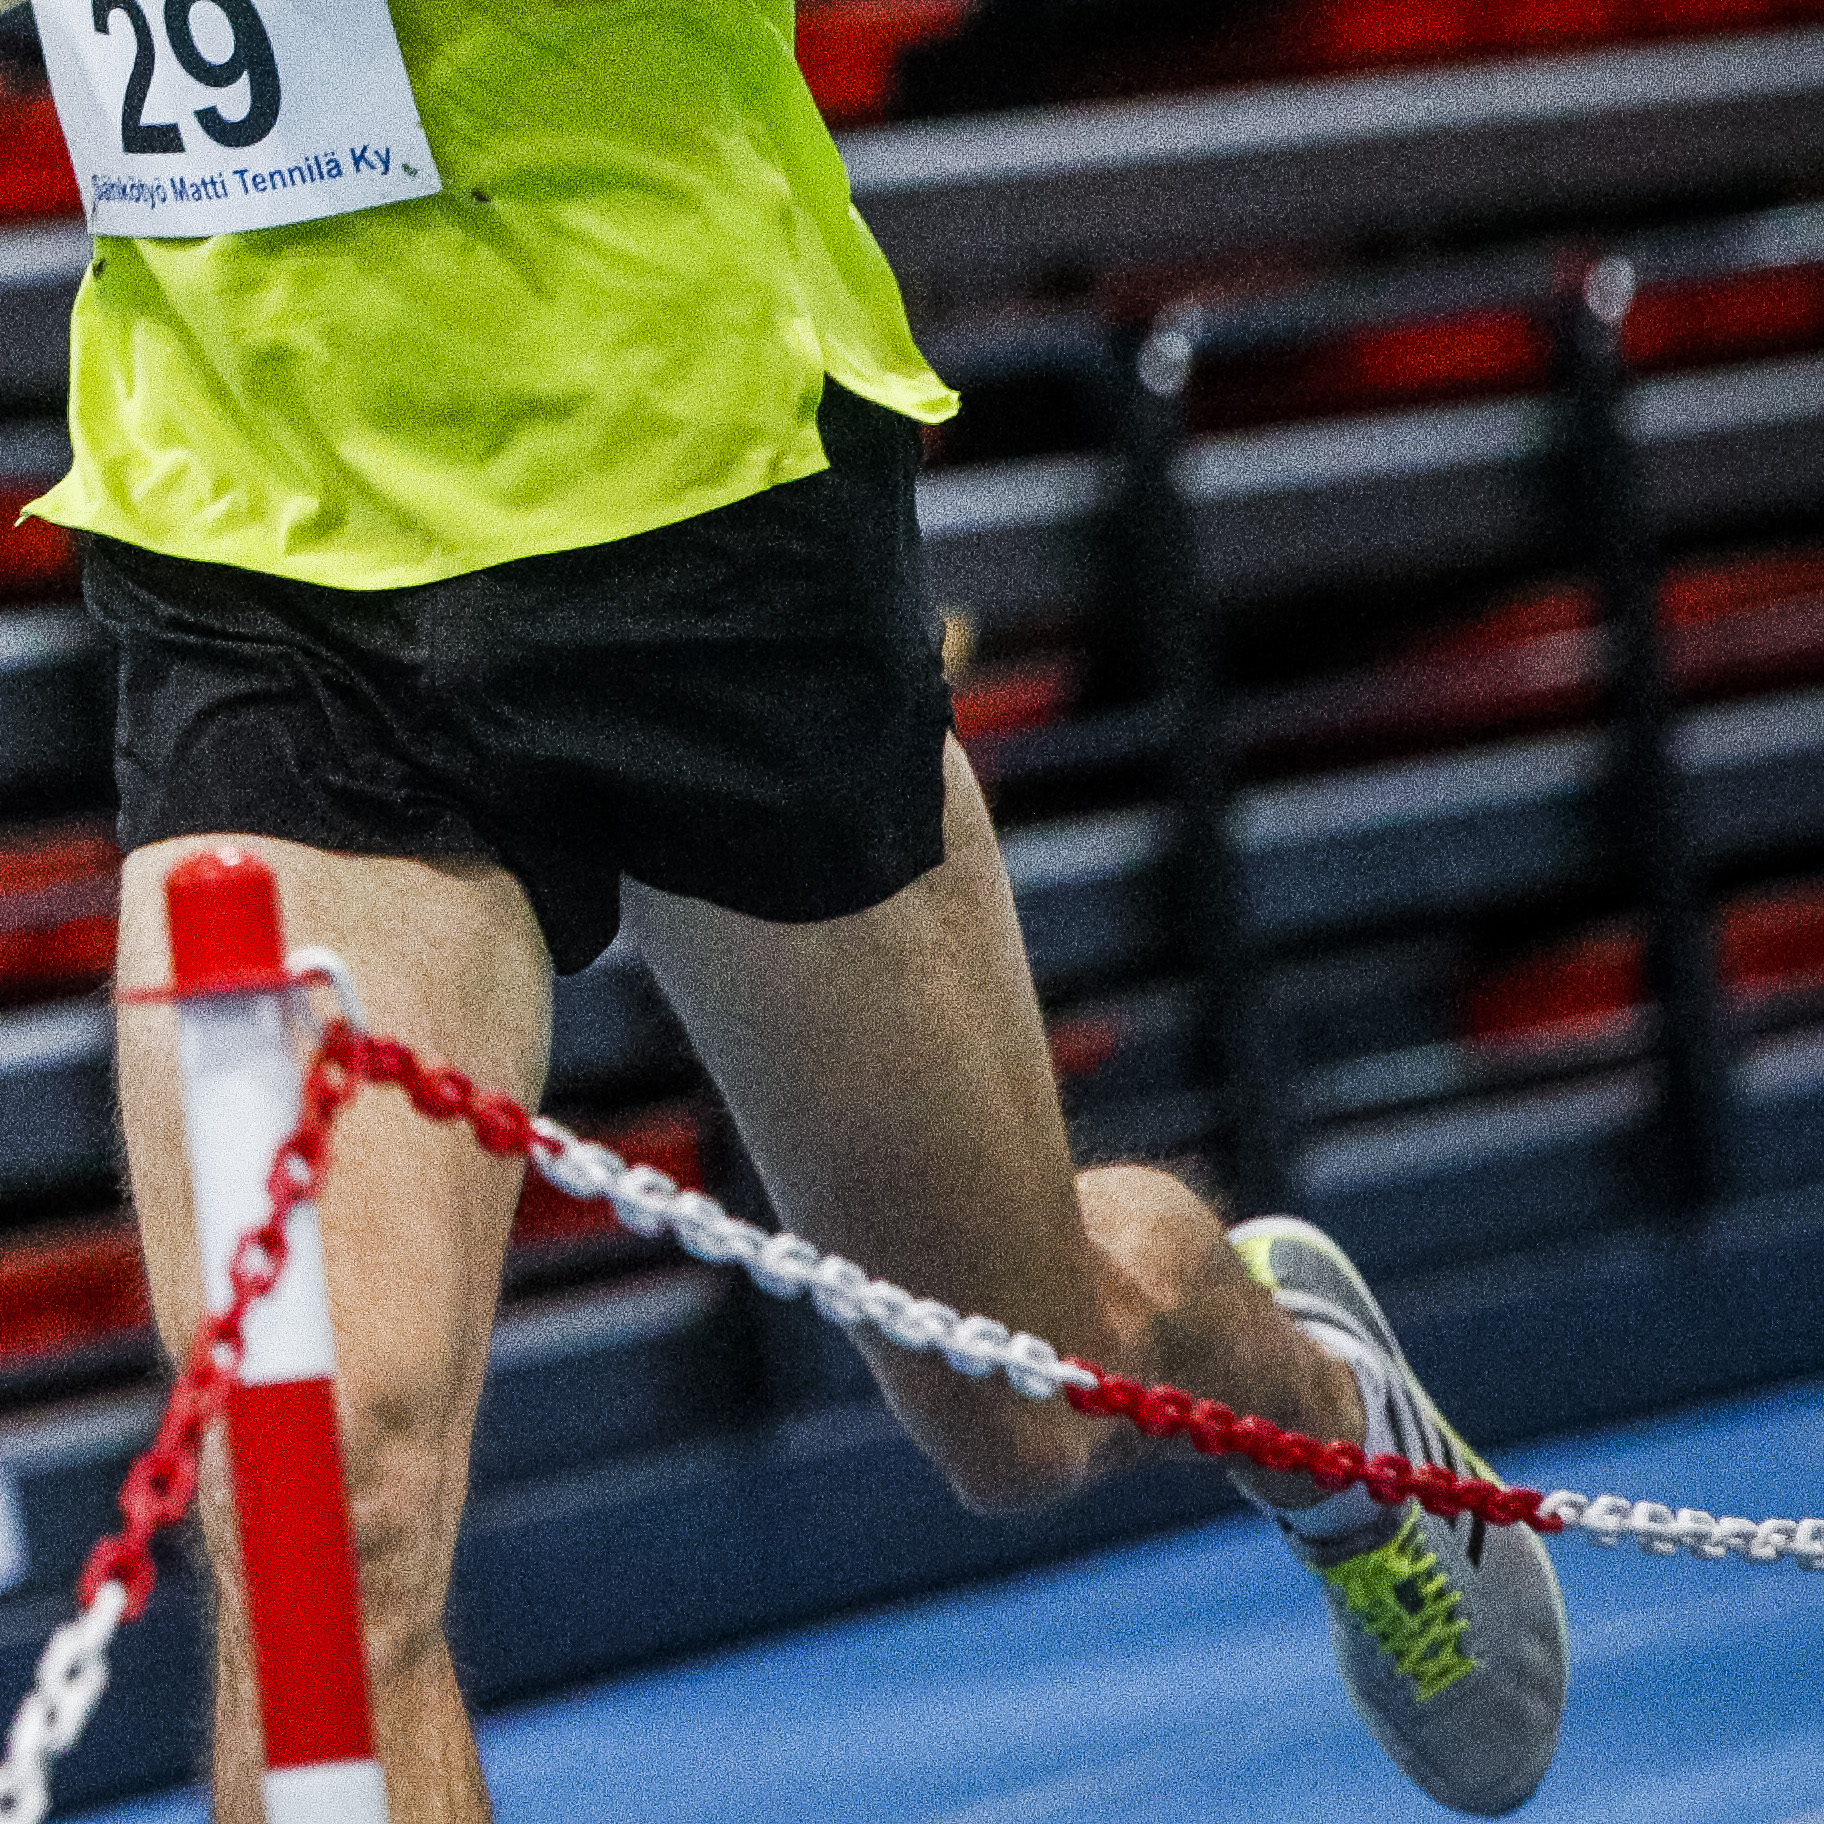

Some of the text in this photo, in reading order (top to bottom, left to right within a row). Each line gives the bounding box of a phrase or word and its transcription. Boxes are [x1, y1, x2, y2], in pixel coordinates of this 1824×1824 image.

[169, 171, 229, 203] Matti
[233, 150, 344, 197] Tennilä
[349, 143, 392, 176] Ky
